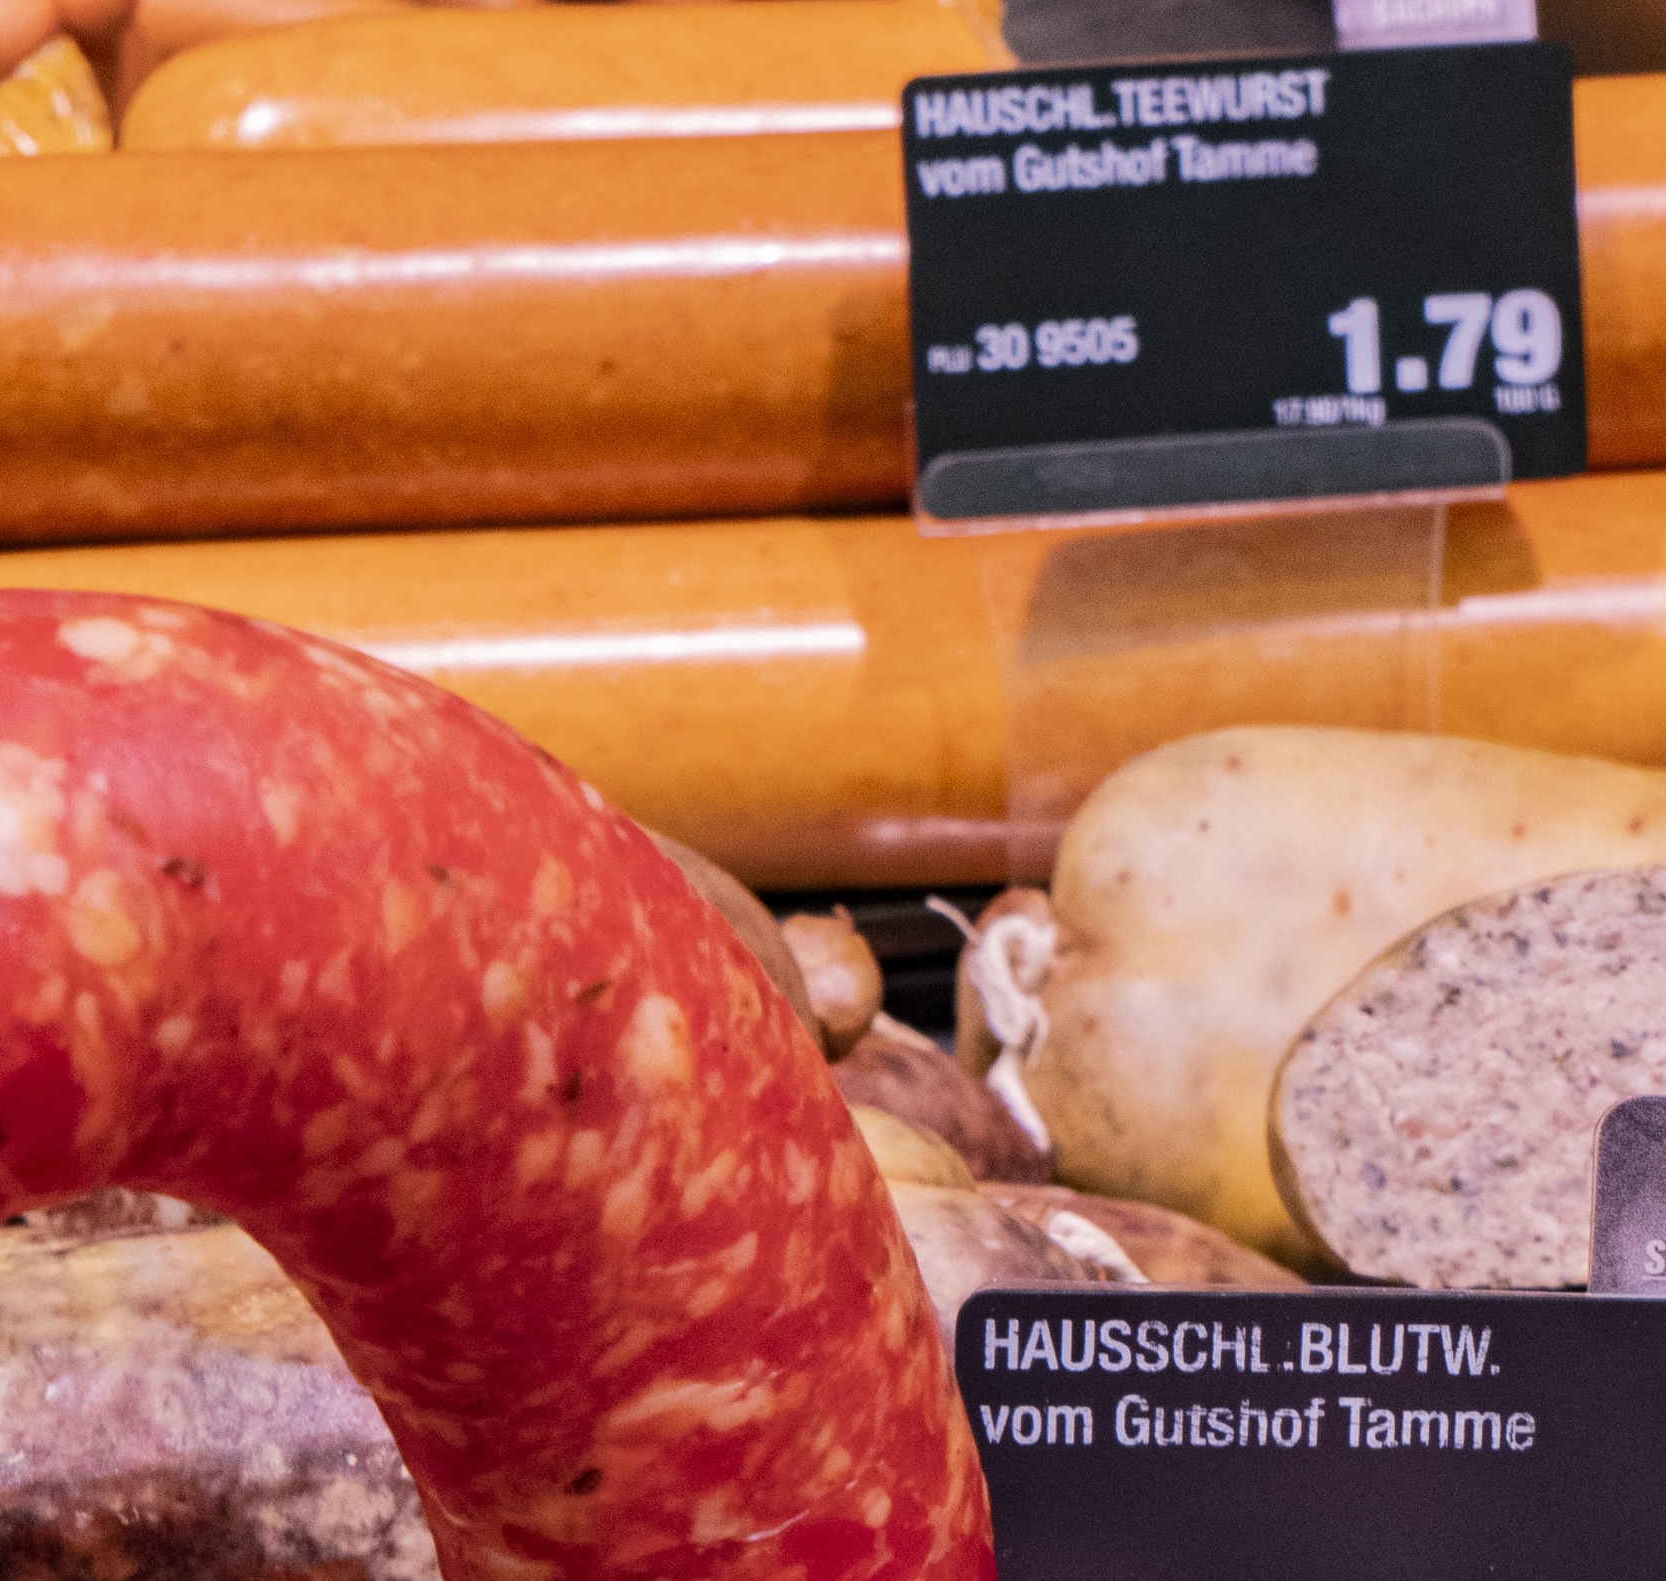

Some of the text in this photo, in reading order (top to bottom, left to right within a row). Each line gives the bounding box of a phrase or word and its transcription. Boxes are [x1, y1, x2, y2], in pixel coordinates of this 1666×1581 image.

[915, 69, 1328, 137] HAUSCHL.TEEWURST
[918, 134, 1318, 197] vom Gutshof Tamme
[975, 323, 1031, 372] 30
[1035, 316, 1139, 368] 9505
[1329, 289, 1562, 394] 1.79
[980, 1393, 1536, 1451] vom Gutshof Tamme
